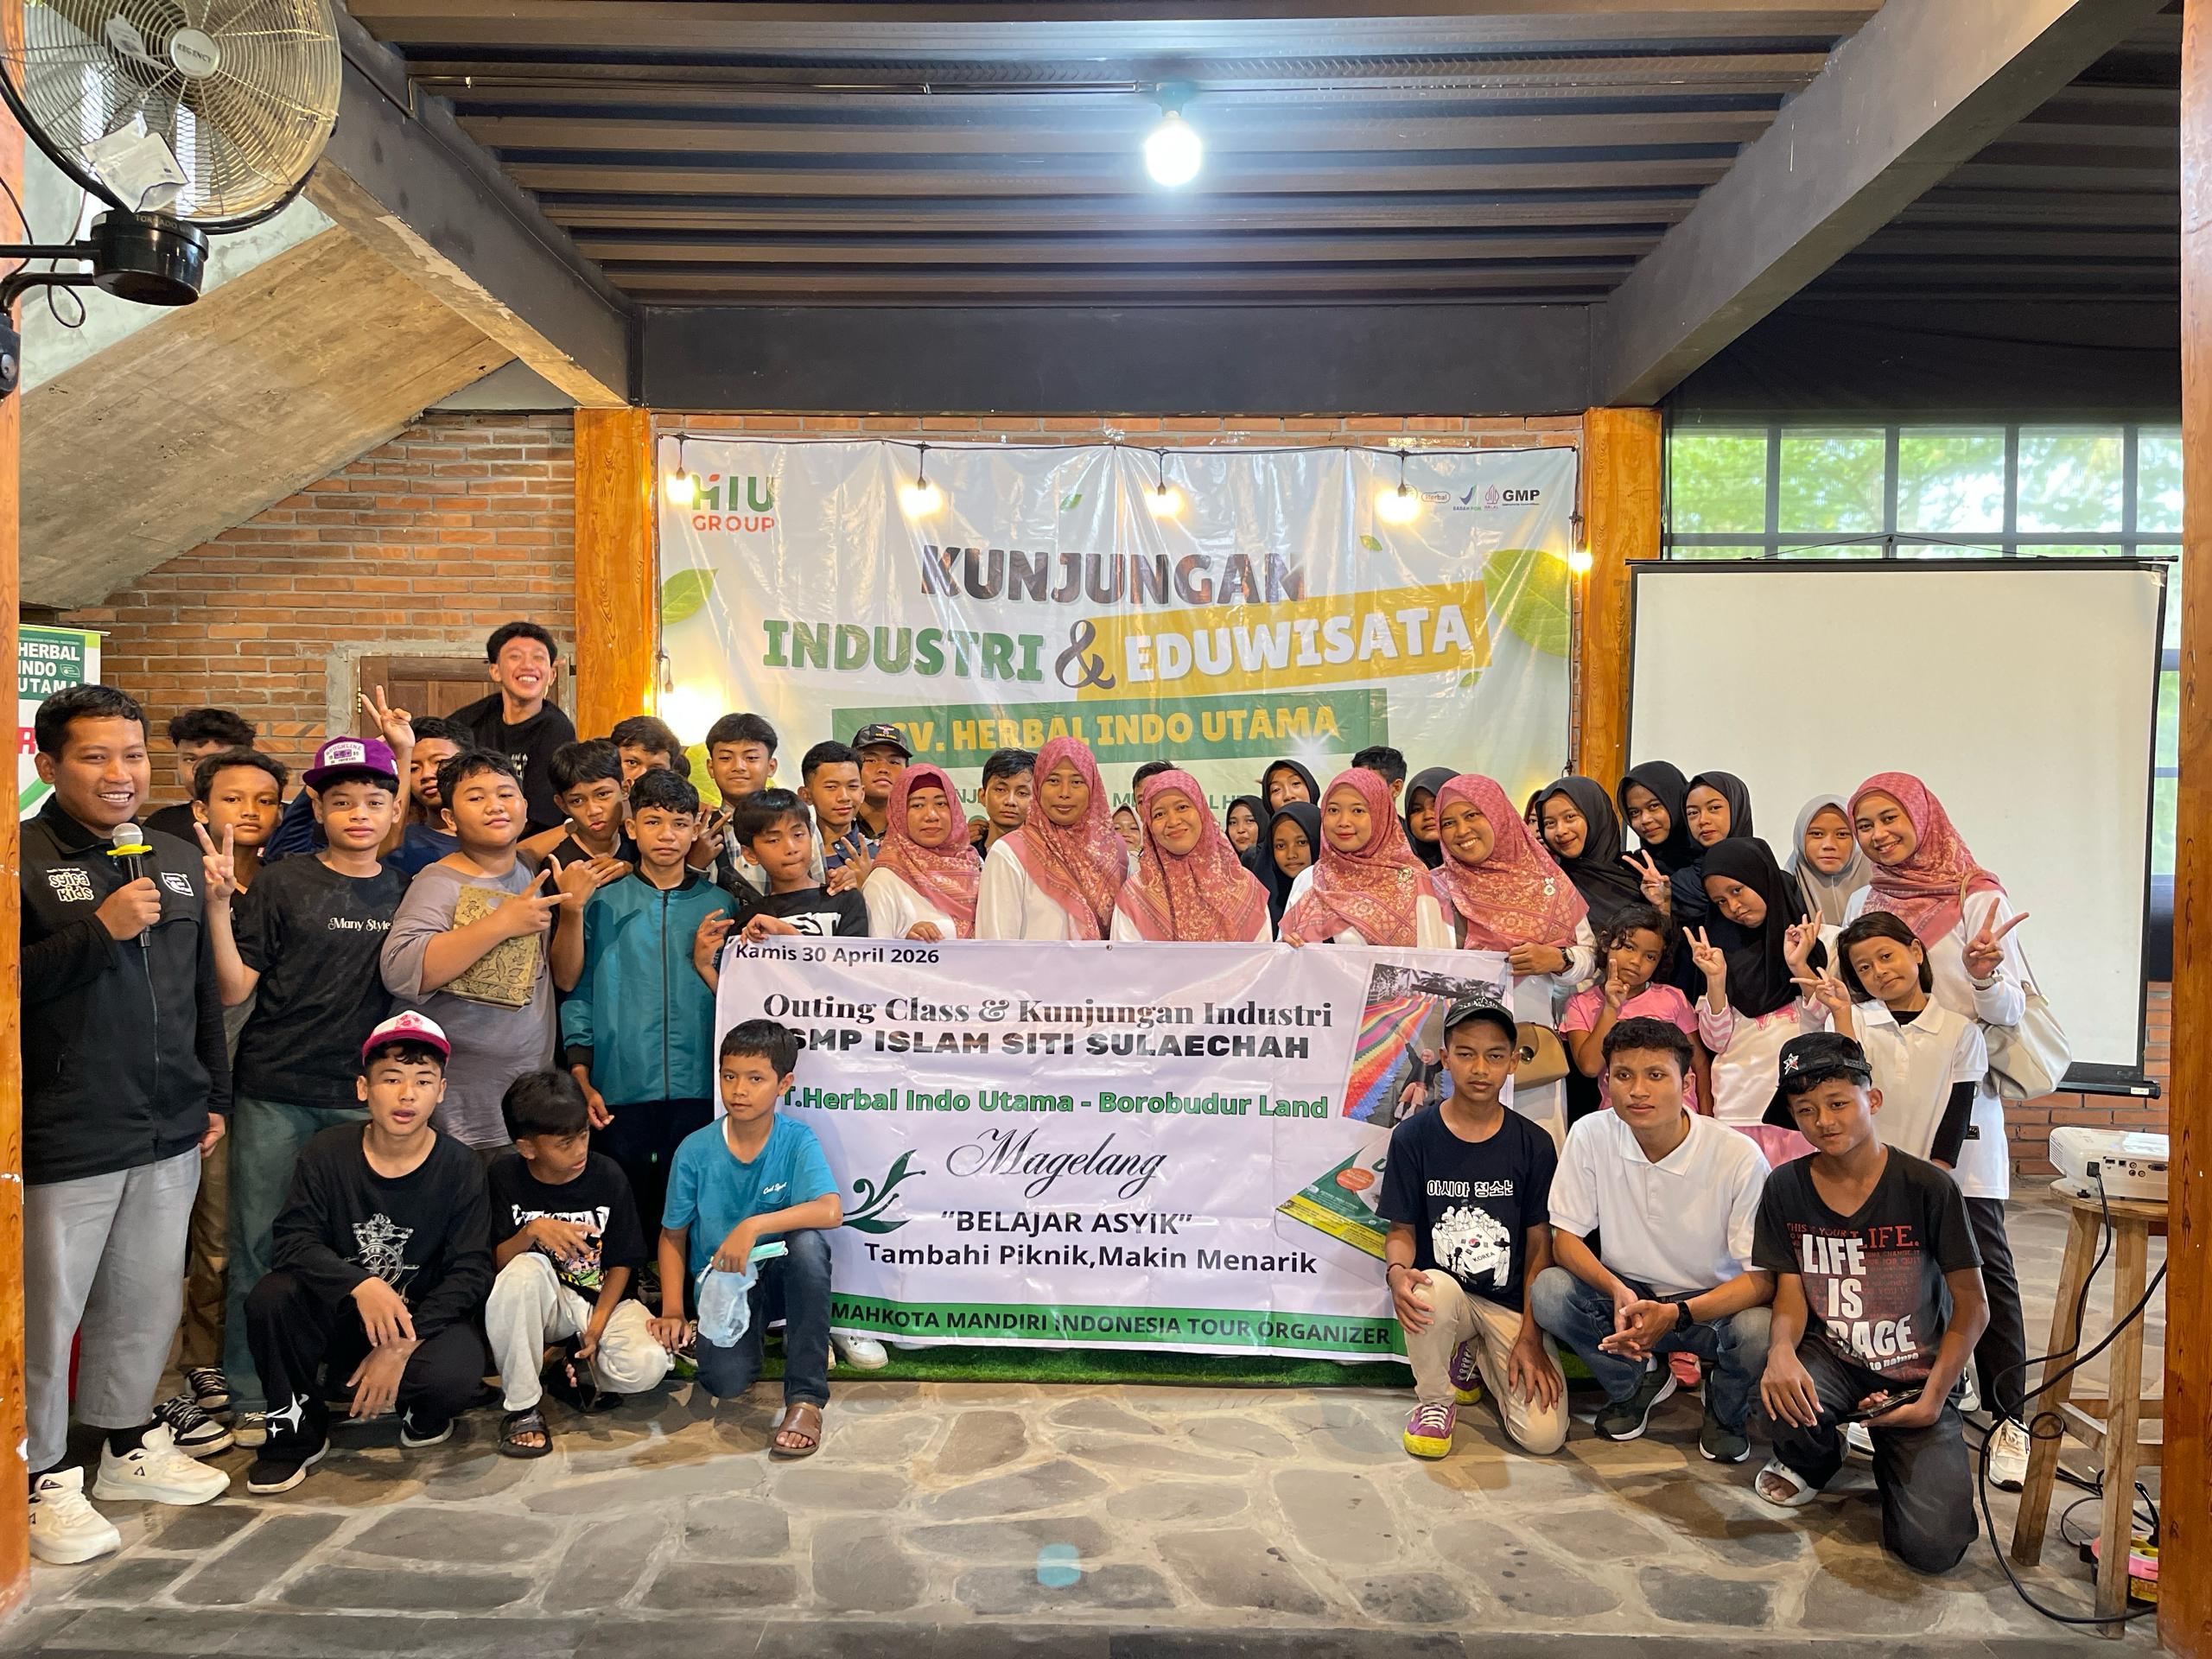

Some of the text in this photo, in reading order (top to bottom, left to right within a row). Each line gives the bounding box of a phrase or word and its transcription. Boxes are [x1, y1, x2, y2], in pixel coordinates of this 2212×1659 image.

[1503, 489, 1541, 502] GMP
[692, 515, 775, 533] GROUP
[921, 544, 1306, 604] KUNJUNGAN
[18, 642, 80, 661] HERBAL
[762, 605, 1473, 689] INDUSTRI & EDUWISATA
[18, 660, 57, 677] INDO
[953, 715, 1096, 749] HERBAL
[1096, 710, 1193, 746] INDO
[1202, 705, 1339, 740] UTAMA
[328, 918, 393, 932] Many Style
[735, 944, 940, 968] Kamis 30 April 2026
[763, 993, 1333, 1028] Outing Class & Kunjungan Industri
[791, 1027, 1309, 1059] SMP ISLAM SITI SULAECHAH
[906, 1089, 971, 1113] Indo
[979, 1090, 1074, 1113] Utama
[1099, 1092, 1252, 1115] Borobudur
[1259, 1095, 1328, 1119] Land
[946, 1128, 1168, 1200] Magelang
[1427, 1179, 1470, 1198] 아시아
[1819, 1227, 1847, 1237] YOUR
[864, 1242, 989, 1268] Tambahi
[1197, 1249, 1319, 1274] Menarik
[1472, 1251, 1495, 1262] KOREA
[1802, 1233, 1866, 1275] LIFE
[1827, 1278, 1863, 1319] IS
[831, 1301, 1390, 1346] MAHKOTA MANDIRI INDONESIA TOUR ORGANIZER
